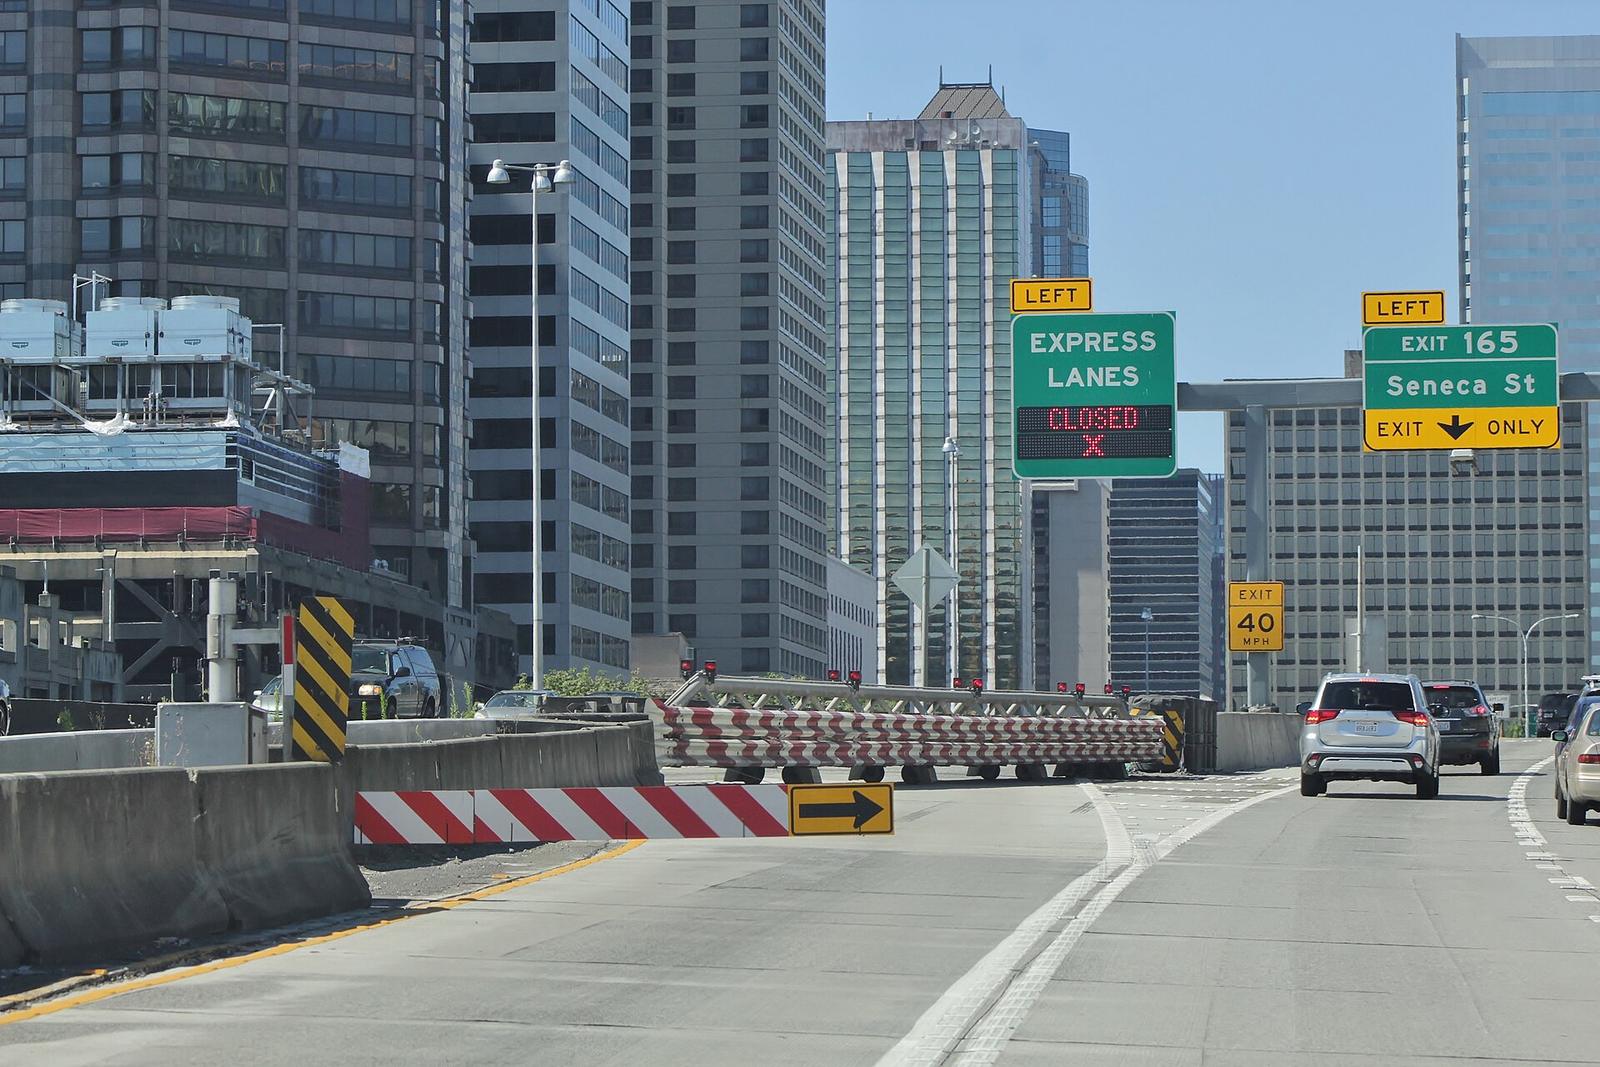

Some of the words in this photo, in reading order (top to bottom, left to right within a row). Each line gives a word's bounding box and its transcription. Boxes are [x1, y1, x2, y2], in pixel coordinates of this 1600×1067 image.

[1026, 288, 1077, 303] LEFT
[1378, 300, 1430, 316] LEFT
[1030, 330, 1157, 353] EXPRESS
[1402, 335, 1448, 352] EXIT
[1464, 331, 1518, 354] 165
[1048, 366, 1139, 388] LANES
[1386, 375, 1487, 396] Seneca
[1504, 373, 1536, 394] St
[1049, 407, 1137, 430] CLOSED
[1378, 422, 1423, 437] EXIT
[1488, 419, 1544, 435] ONLY
[1082, 434, 1104, 457] X
[1239, 589, 1272, 600] EXIT
[1237, 612, 1274, 633] 40
[1243, 637, 1269, 646] MPH
